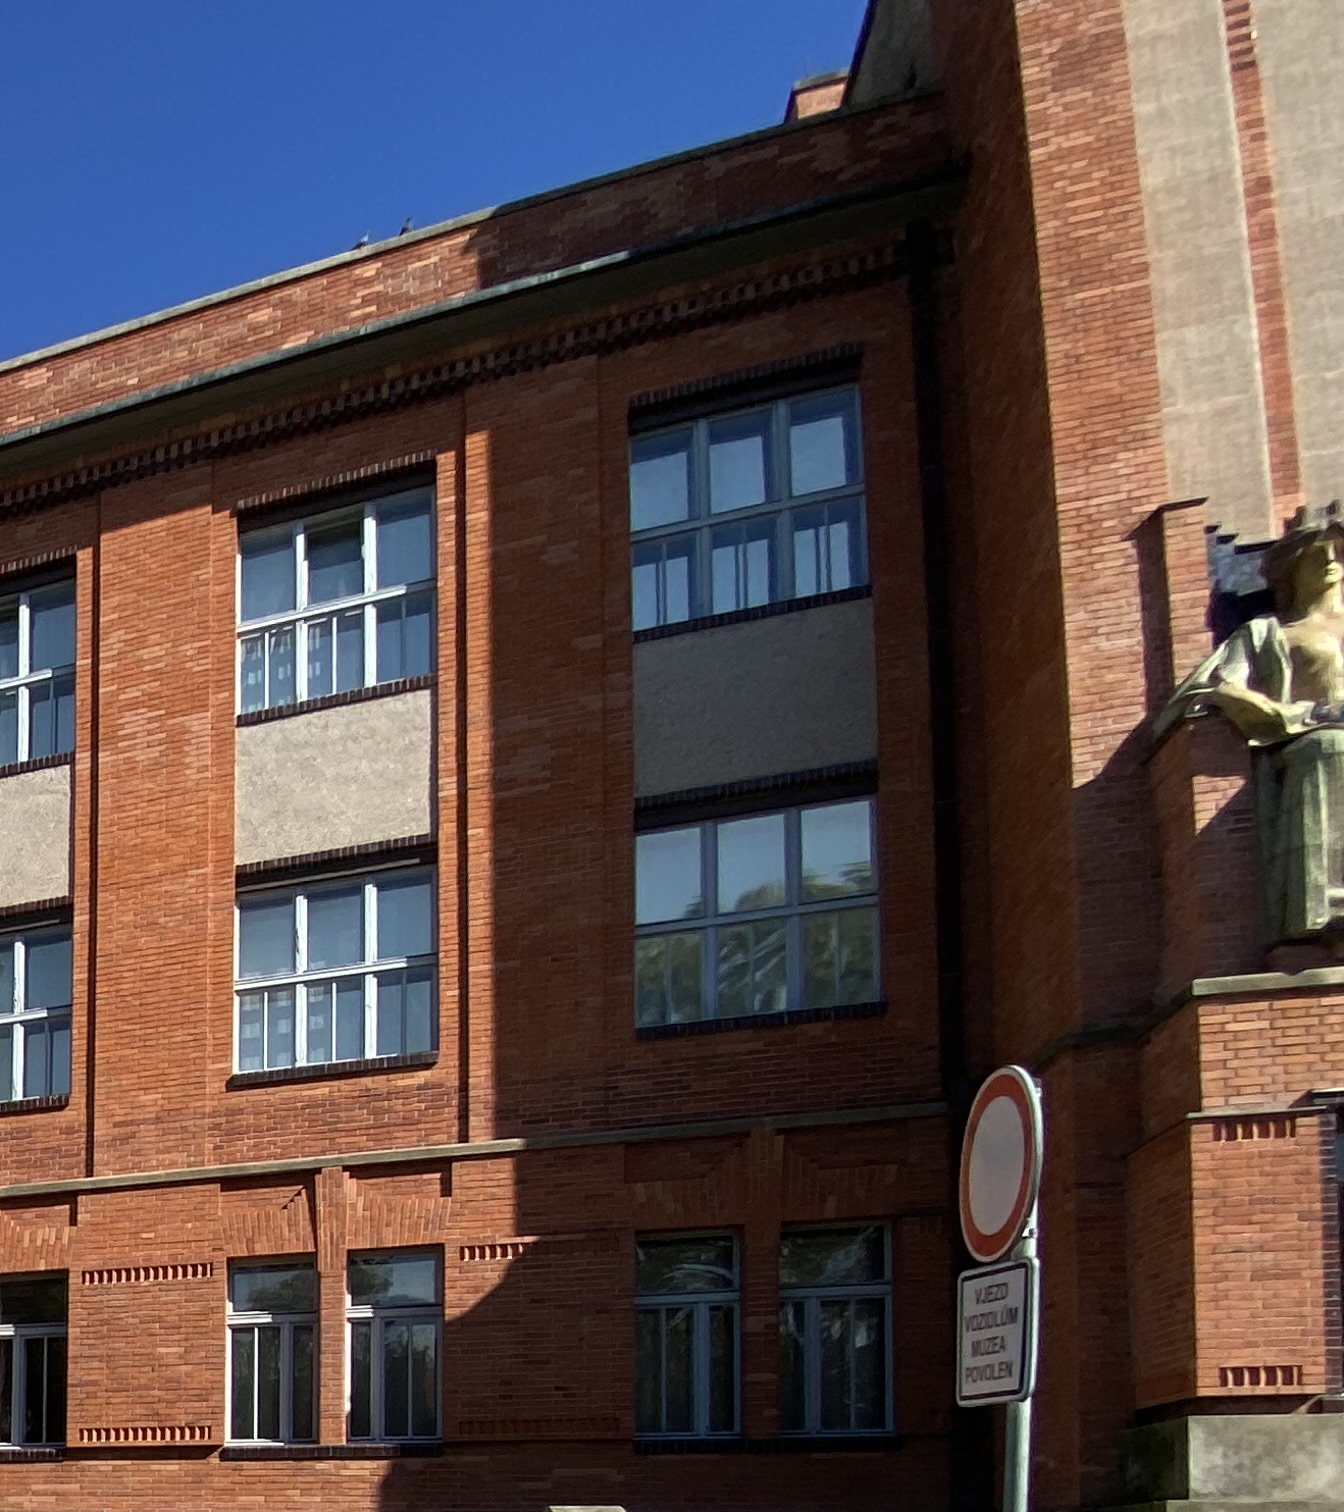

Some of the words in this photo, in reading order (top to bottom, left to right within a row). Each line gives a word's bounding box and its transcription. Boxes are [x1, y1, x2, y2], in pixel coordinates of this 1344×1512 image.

[974, 1282, 1009, 1304] VJEZD
[971, 1335, 1006, 1358] MUZEA
[965, 1361, 1014, 1383] POVOLEN
